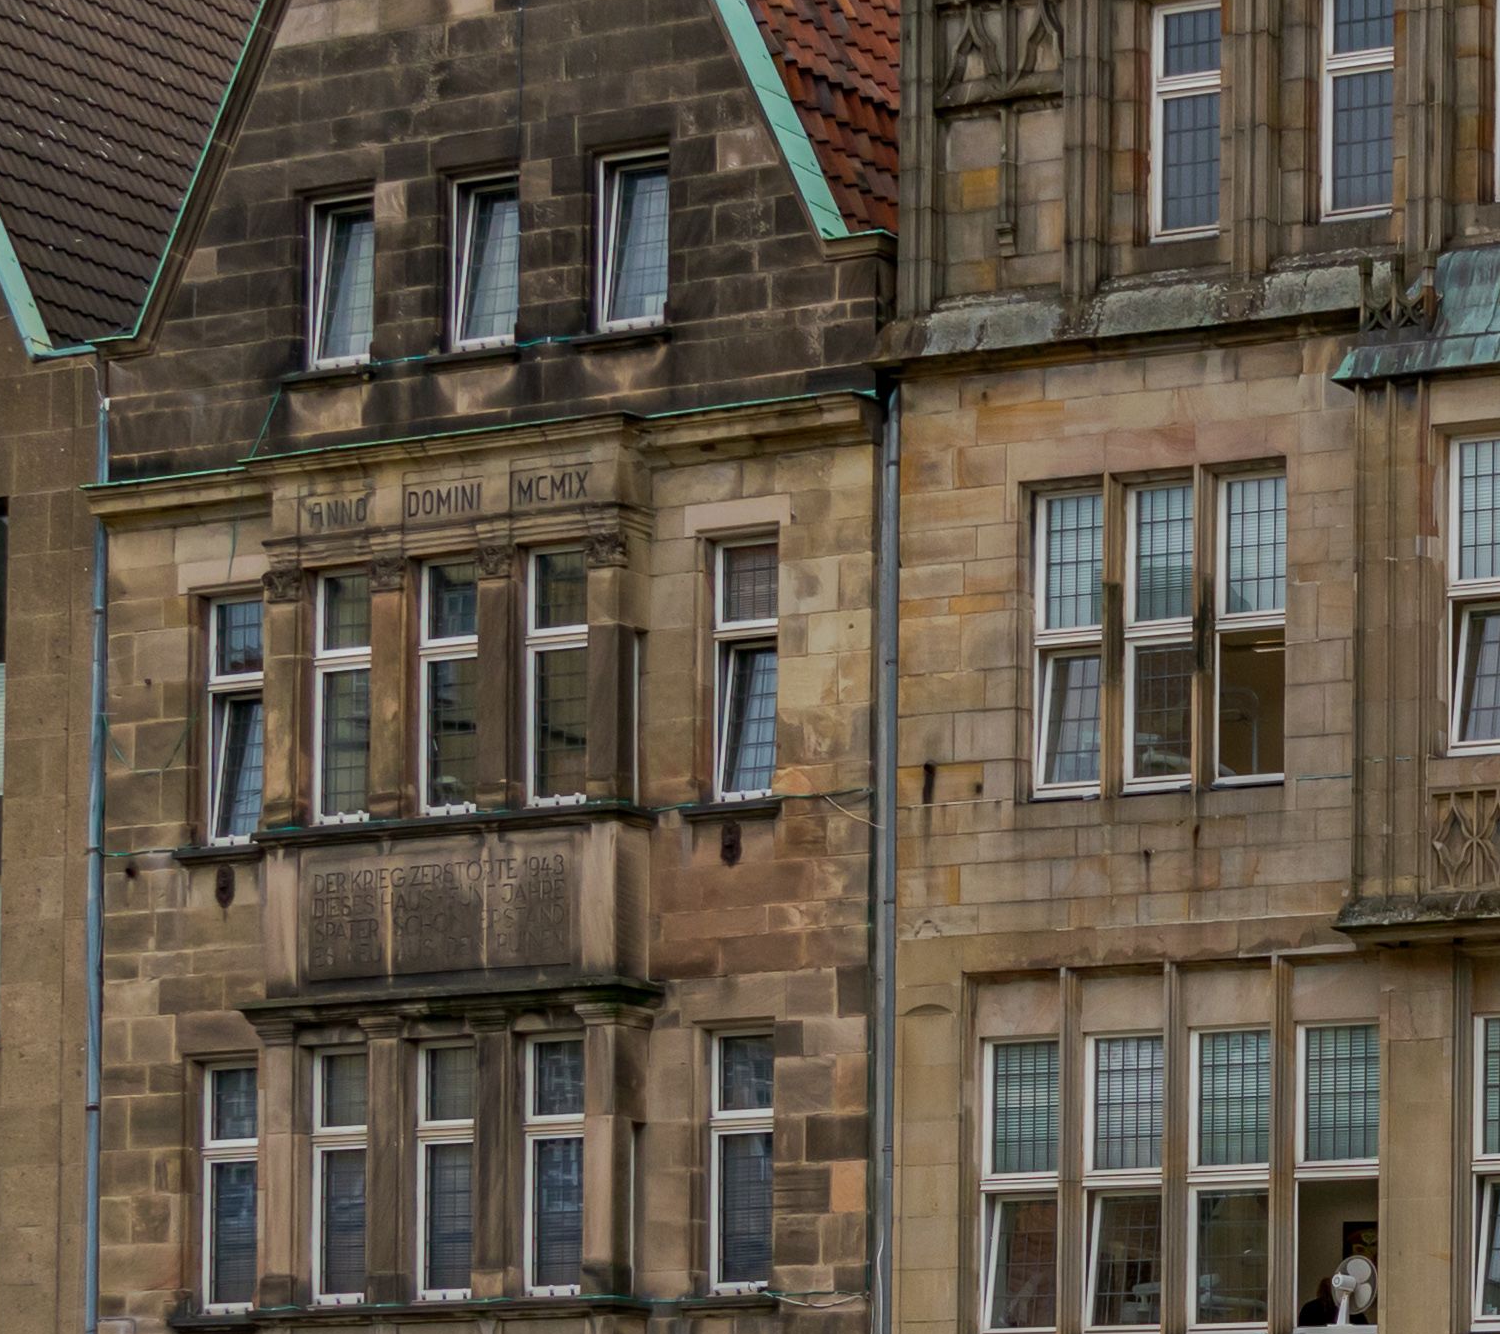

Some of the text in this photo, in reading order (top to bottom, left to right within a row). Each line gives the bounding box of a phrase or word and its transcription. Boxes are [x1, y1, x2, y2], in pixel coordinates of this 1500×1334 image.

[308, 470, 589, 528] ANNO DOMINI MCMIX
[313, 894, 375, 918] DIESES
[502, 879, 565, 903] JAHRE
[314, 872, 347, 895] DER
[351, 866, 406, 890] KRIEG
